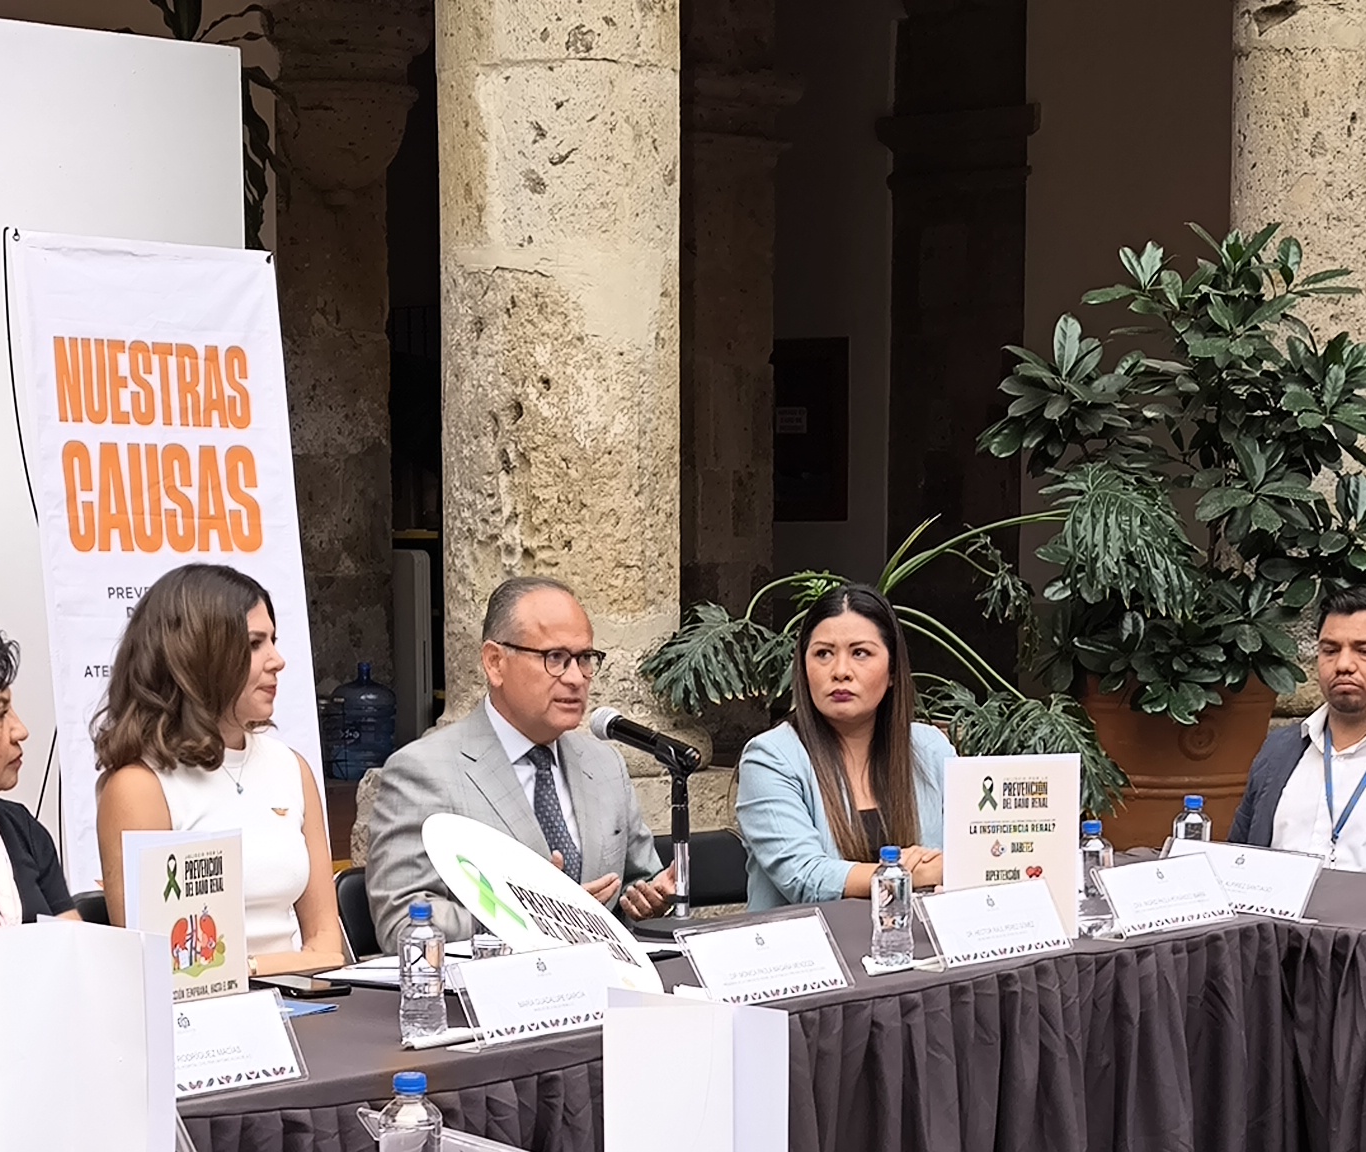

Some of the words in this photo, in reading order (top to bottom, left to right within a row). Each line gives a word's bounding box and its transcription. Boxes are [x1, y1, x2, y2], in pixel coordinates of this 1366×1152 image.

[53, 336, 251, 429] NUESTRAS
[62, 440, 263, 552] CAUSAS
[970, 825, 977, 834] LA
